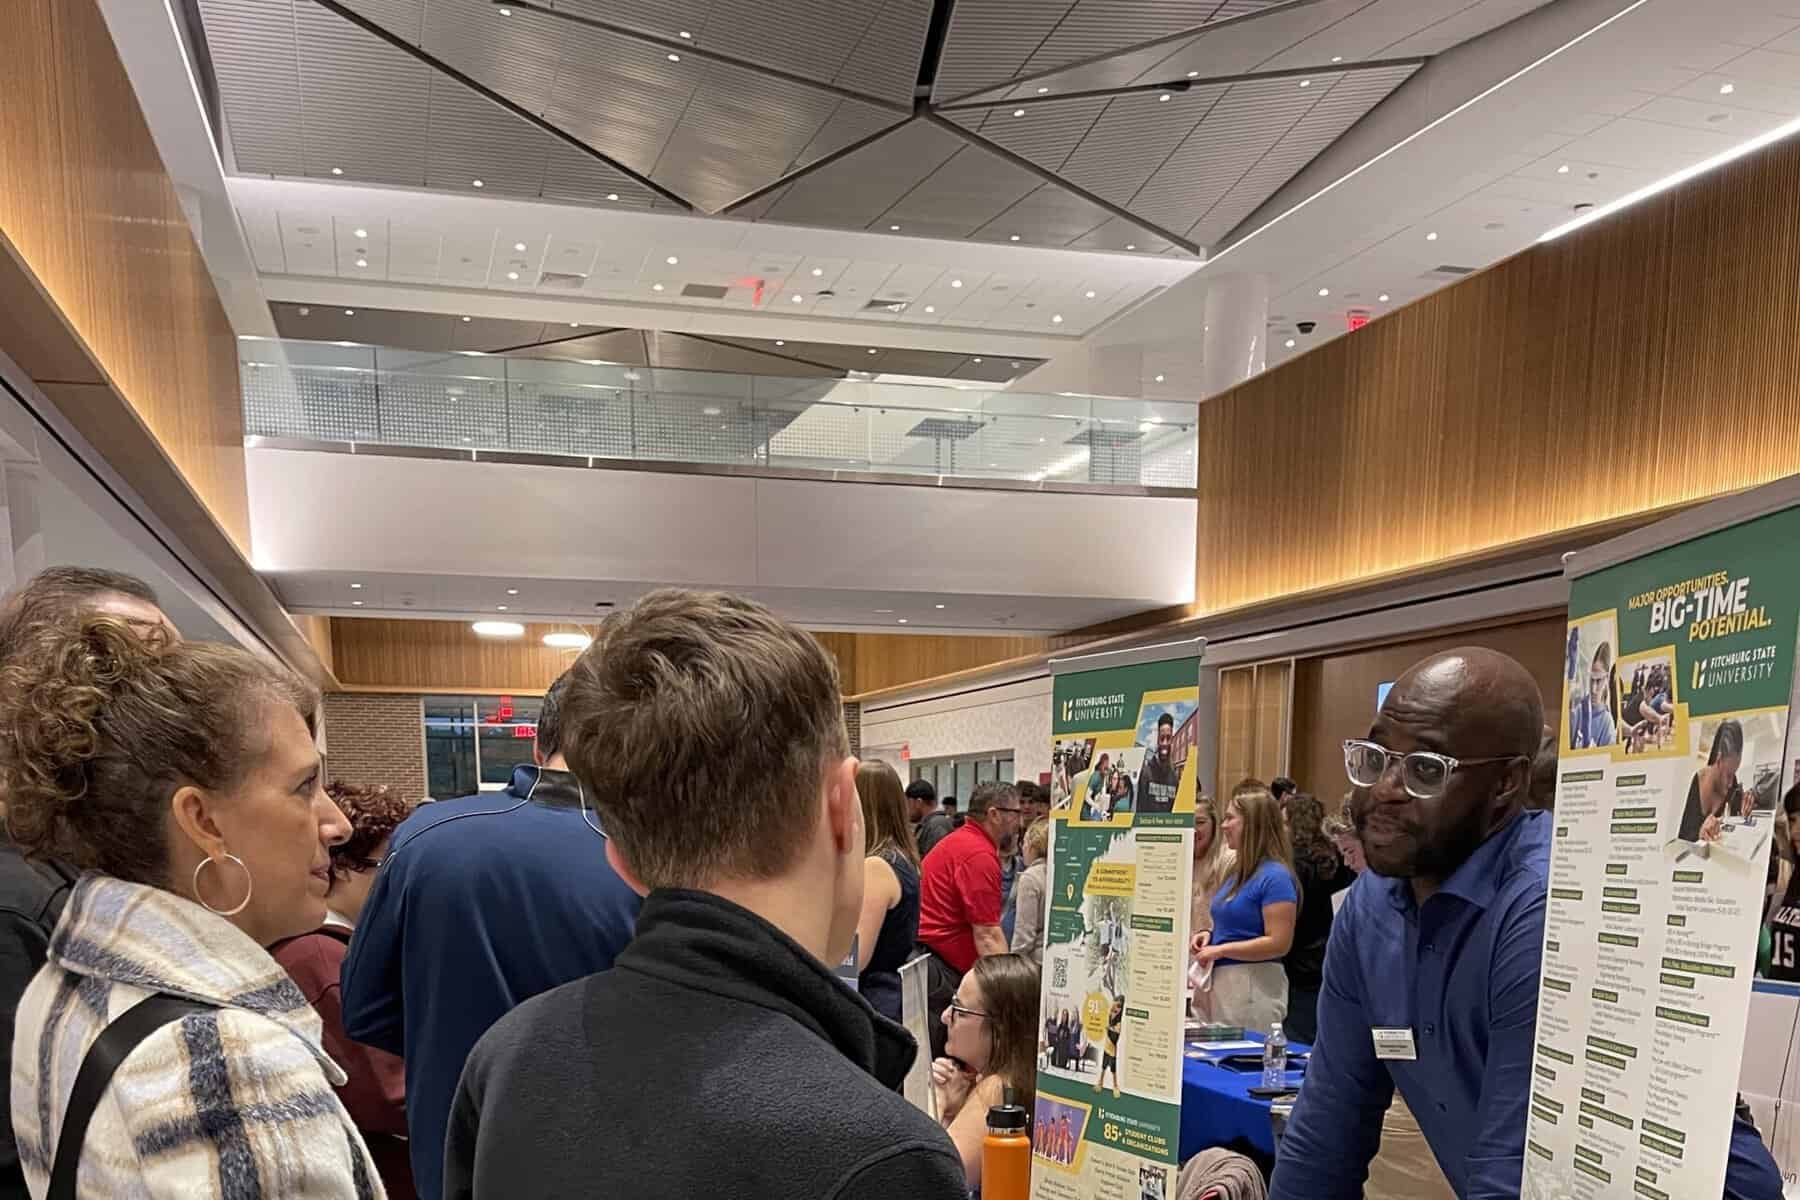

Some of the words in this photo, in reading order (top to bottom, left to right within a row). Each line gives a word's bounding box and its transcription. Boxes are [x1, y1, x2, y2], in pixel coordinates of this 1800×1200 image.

[1628, 591, 1657, 610] MAJOR
[1649, 577, 1750, 634] BIG-TIME
[1688, 605, 1772, 643] POTENTIAL.
[1710, 649, 1751, 669] FITCHBURG
[1751, 645, 1777, 660] STATE
[1708, 661, 1775, 688] UNIVERSITY
[1074, 705, 1125, 721] UNIVERSITY
[1075, 695, 1107, 708] FITCHBURG
[1107, 693, 1126, 705] STATE
[1771, 930, 1796, 968] 15
